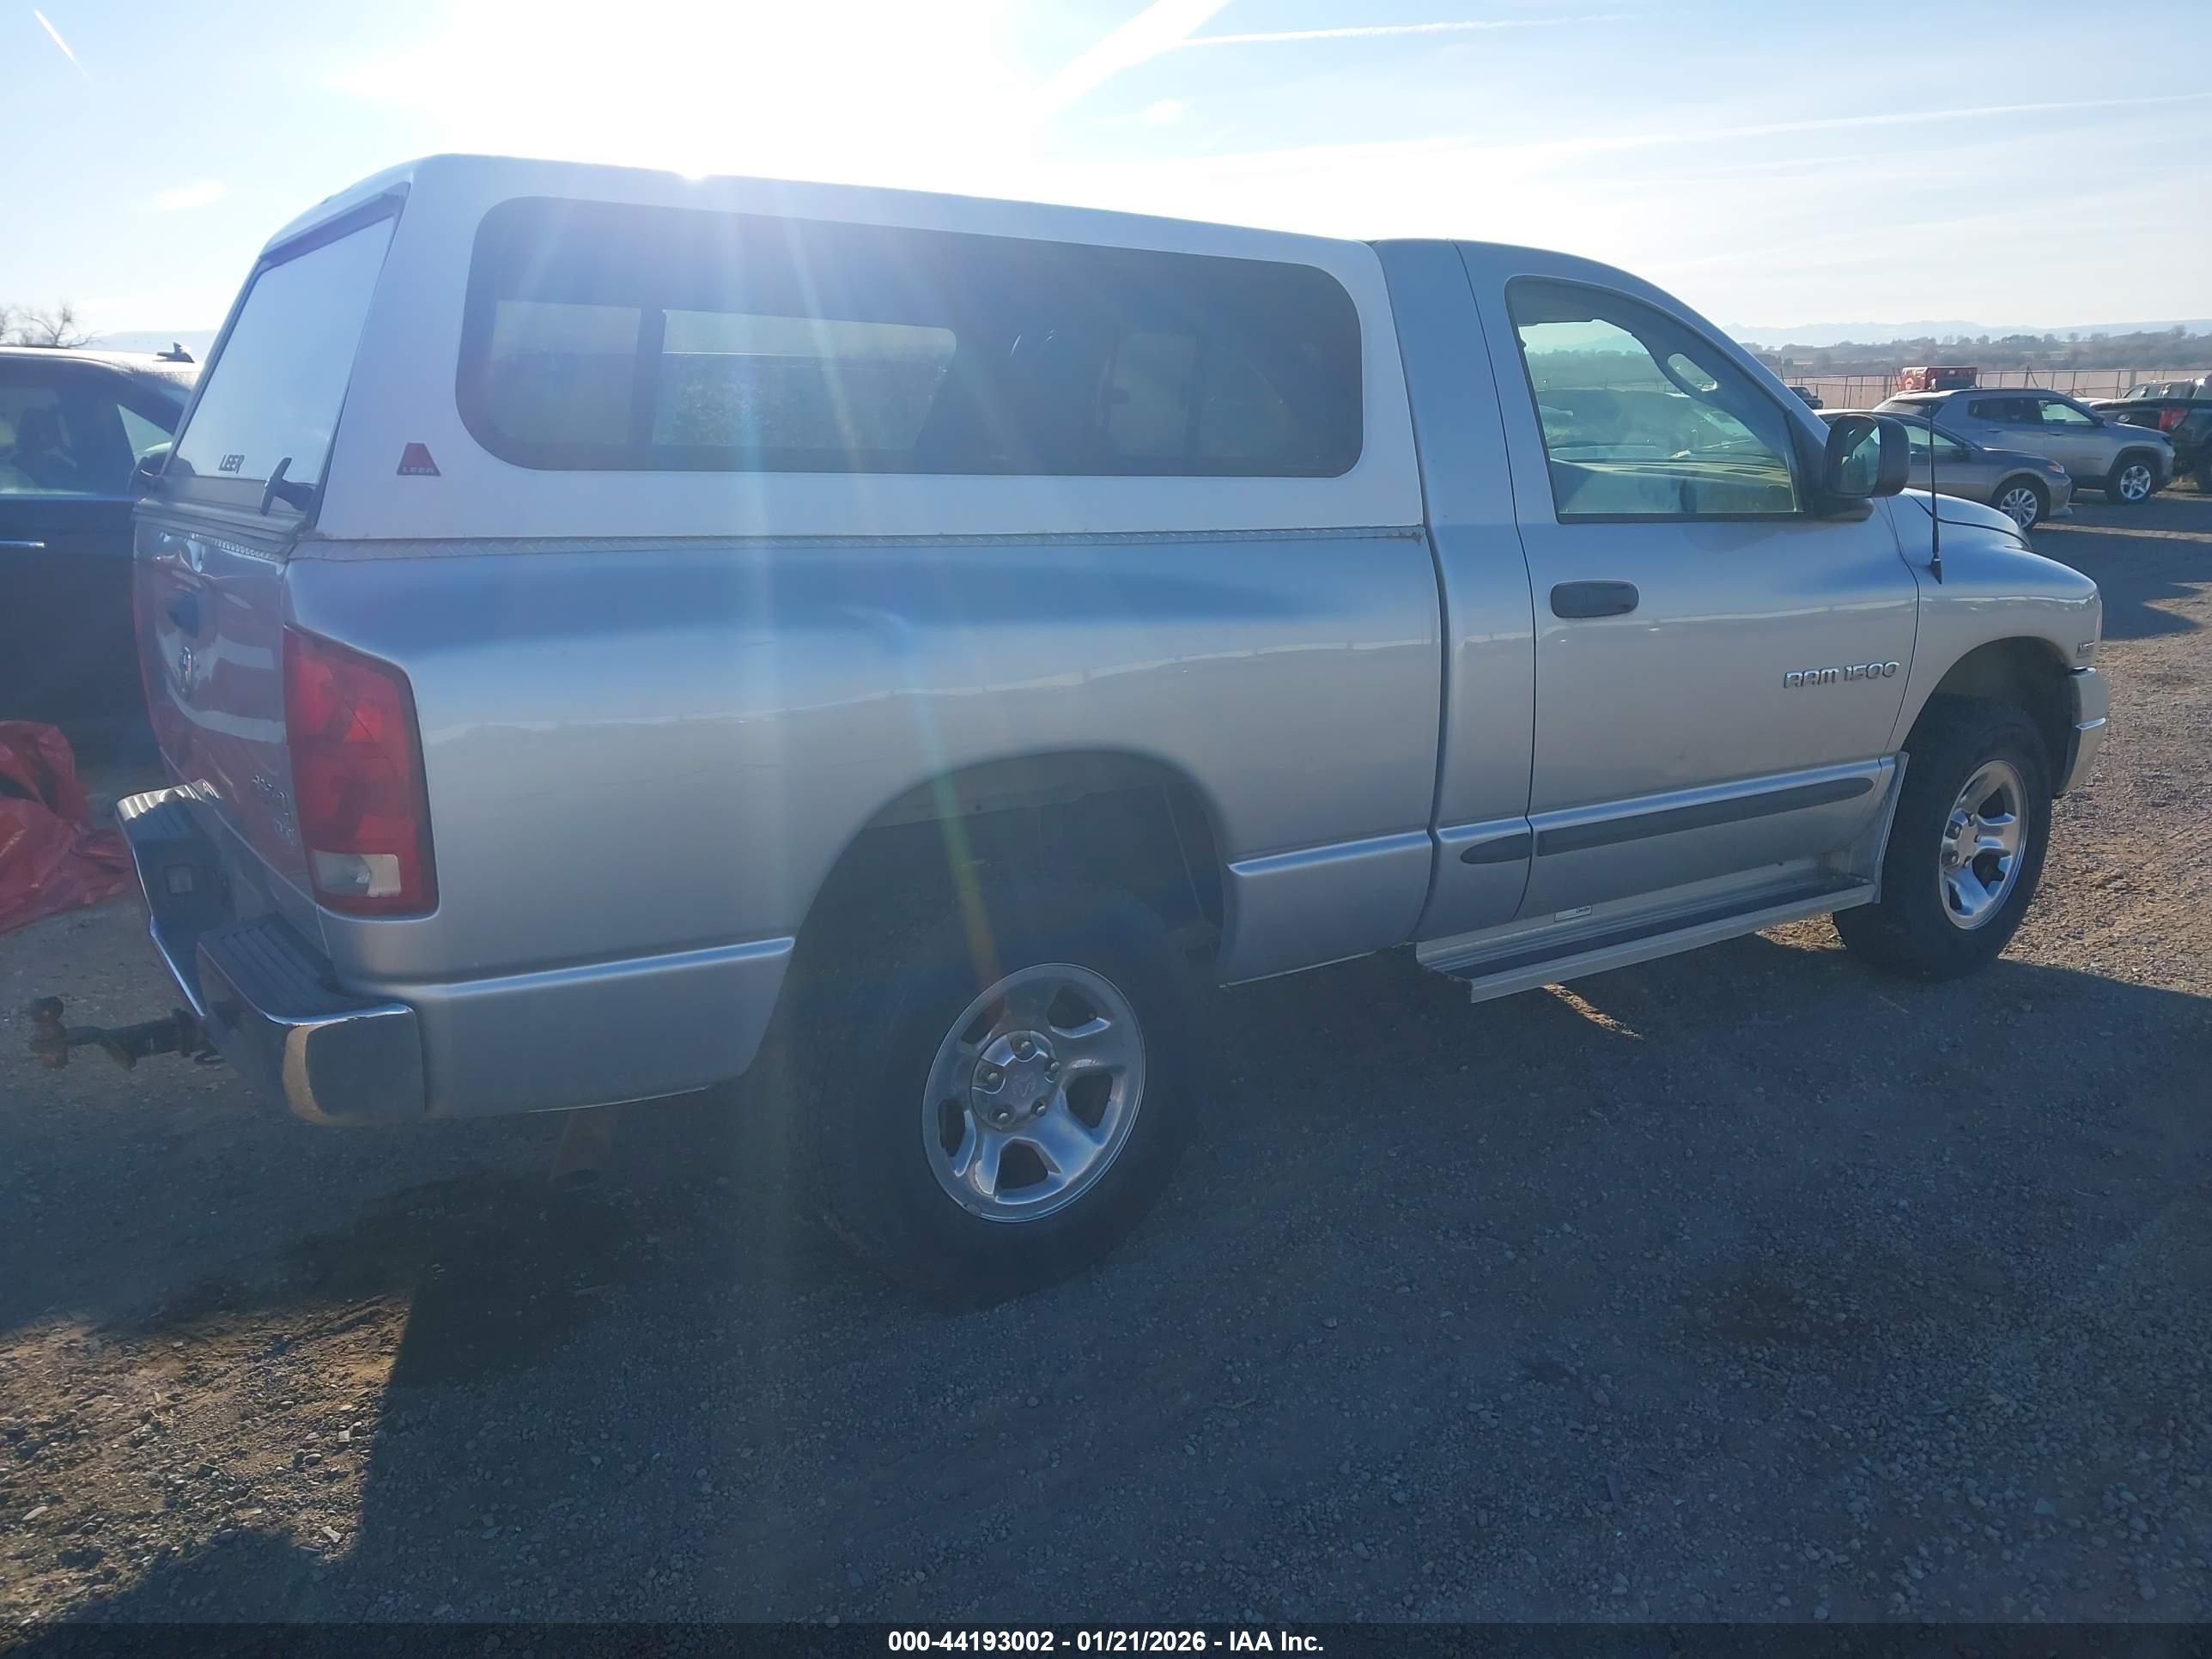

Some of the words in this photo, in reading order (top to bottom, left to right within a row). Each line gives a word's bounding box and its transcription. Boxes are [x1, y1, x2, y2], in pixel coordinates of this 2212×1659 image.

[218, 454, 246, 474] LEER
[1784, 667, 1839, 689] RAM
[1844, 660, 1900, 682] 1500
